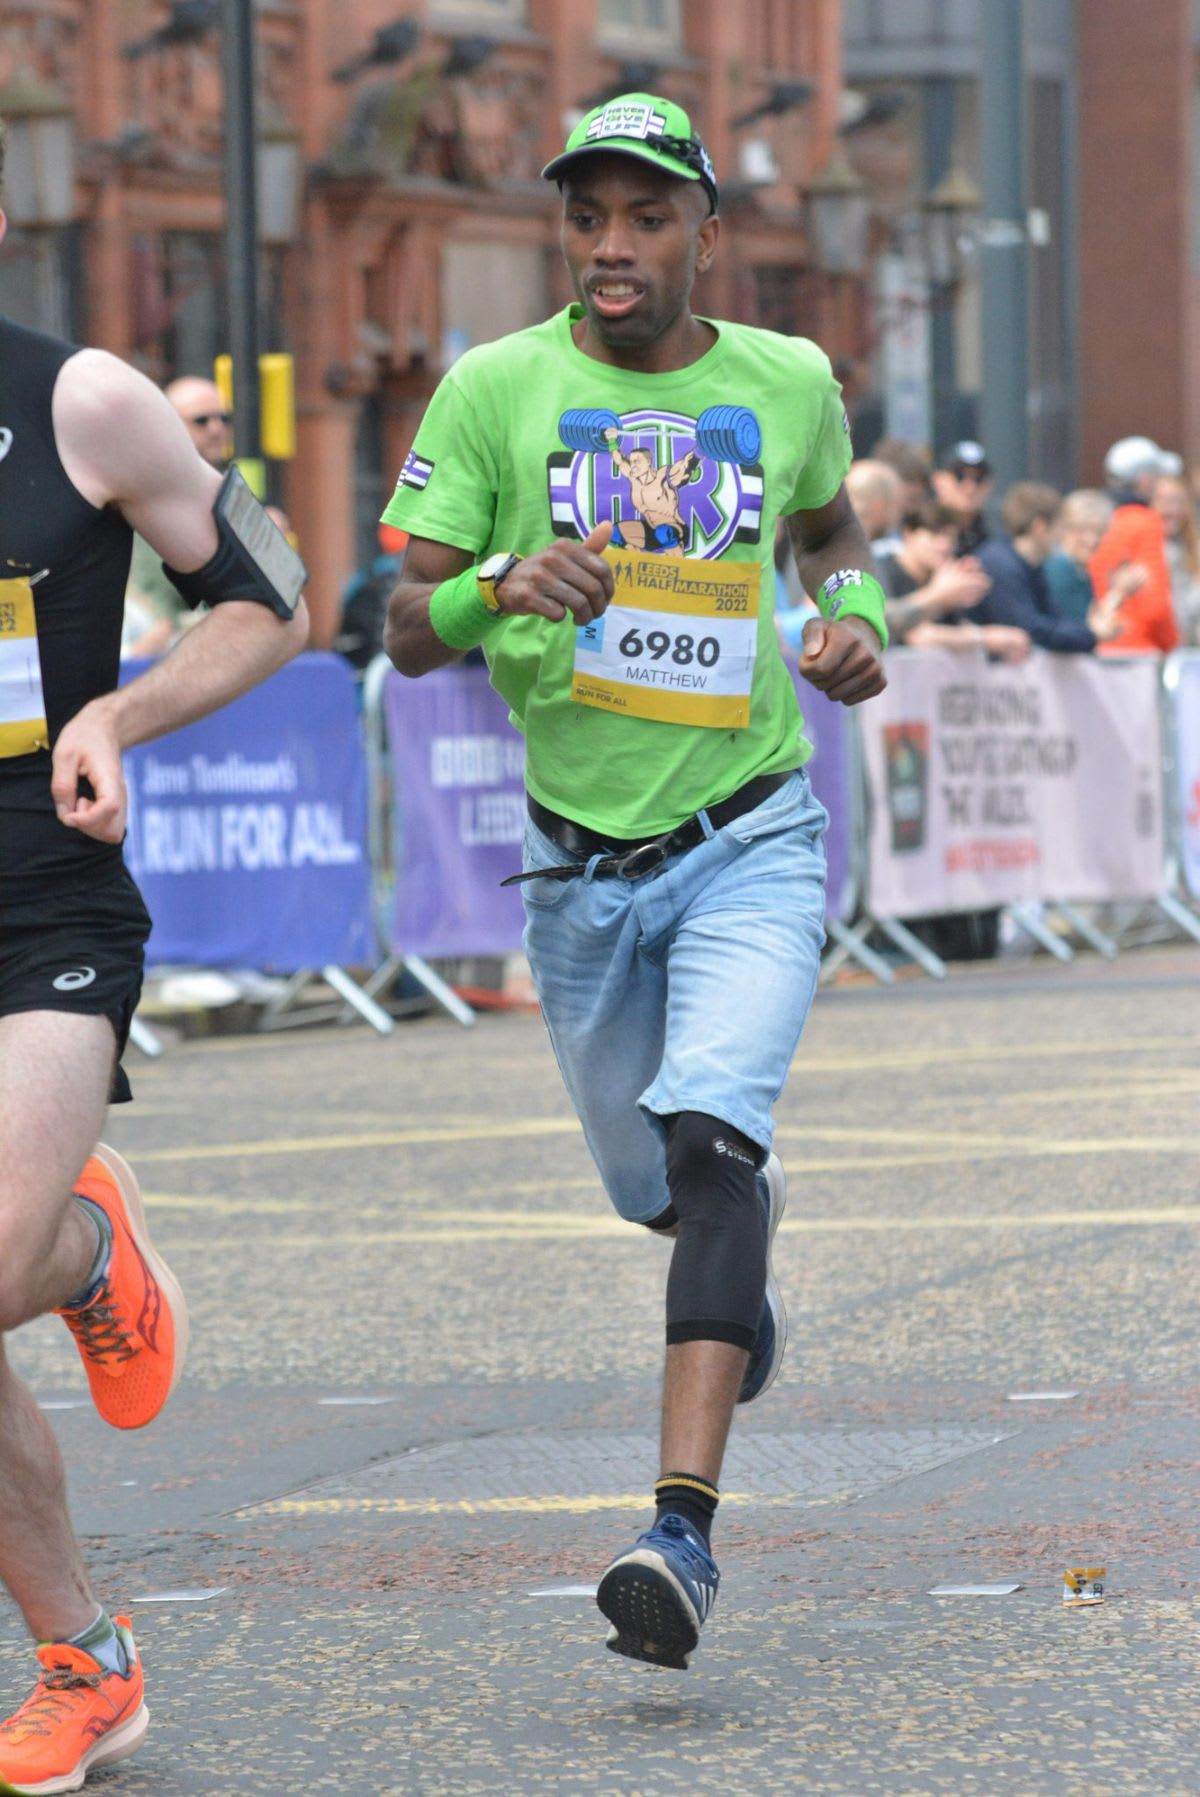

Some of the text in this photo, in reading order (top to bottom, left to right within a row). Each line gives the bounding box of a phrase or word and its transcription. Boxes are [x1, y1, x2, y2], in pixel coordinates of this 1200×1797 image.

[638, 562, 680, 579] LEEDS
[637, 576, 749, 598] HALF MARATHON
[715, 597, 748, 612] 2022
[619, 628, 721, 668] 6980
[626, 666, 708, 689] MATTHEW
[596, 692, 612, 702] FOR
[613, 696, 627, 707] ALL
[144, 807, 217, 873] RUN
[219, 802, 288, 871] FOR
